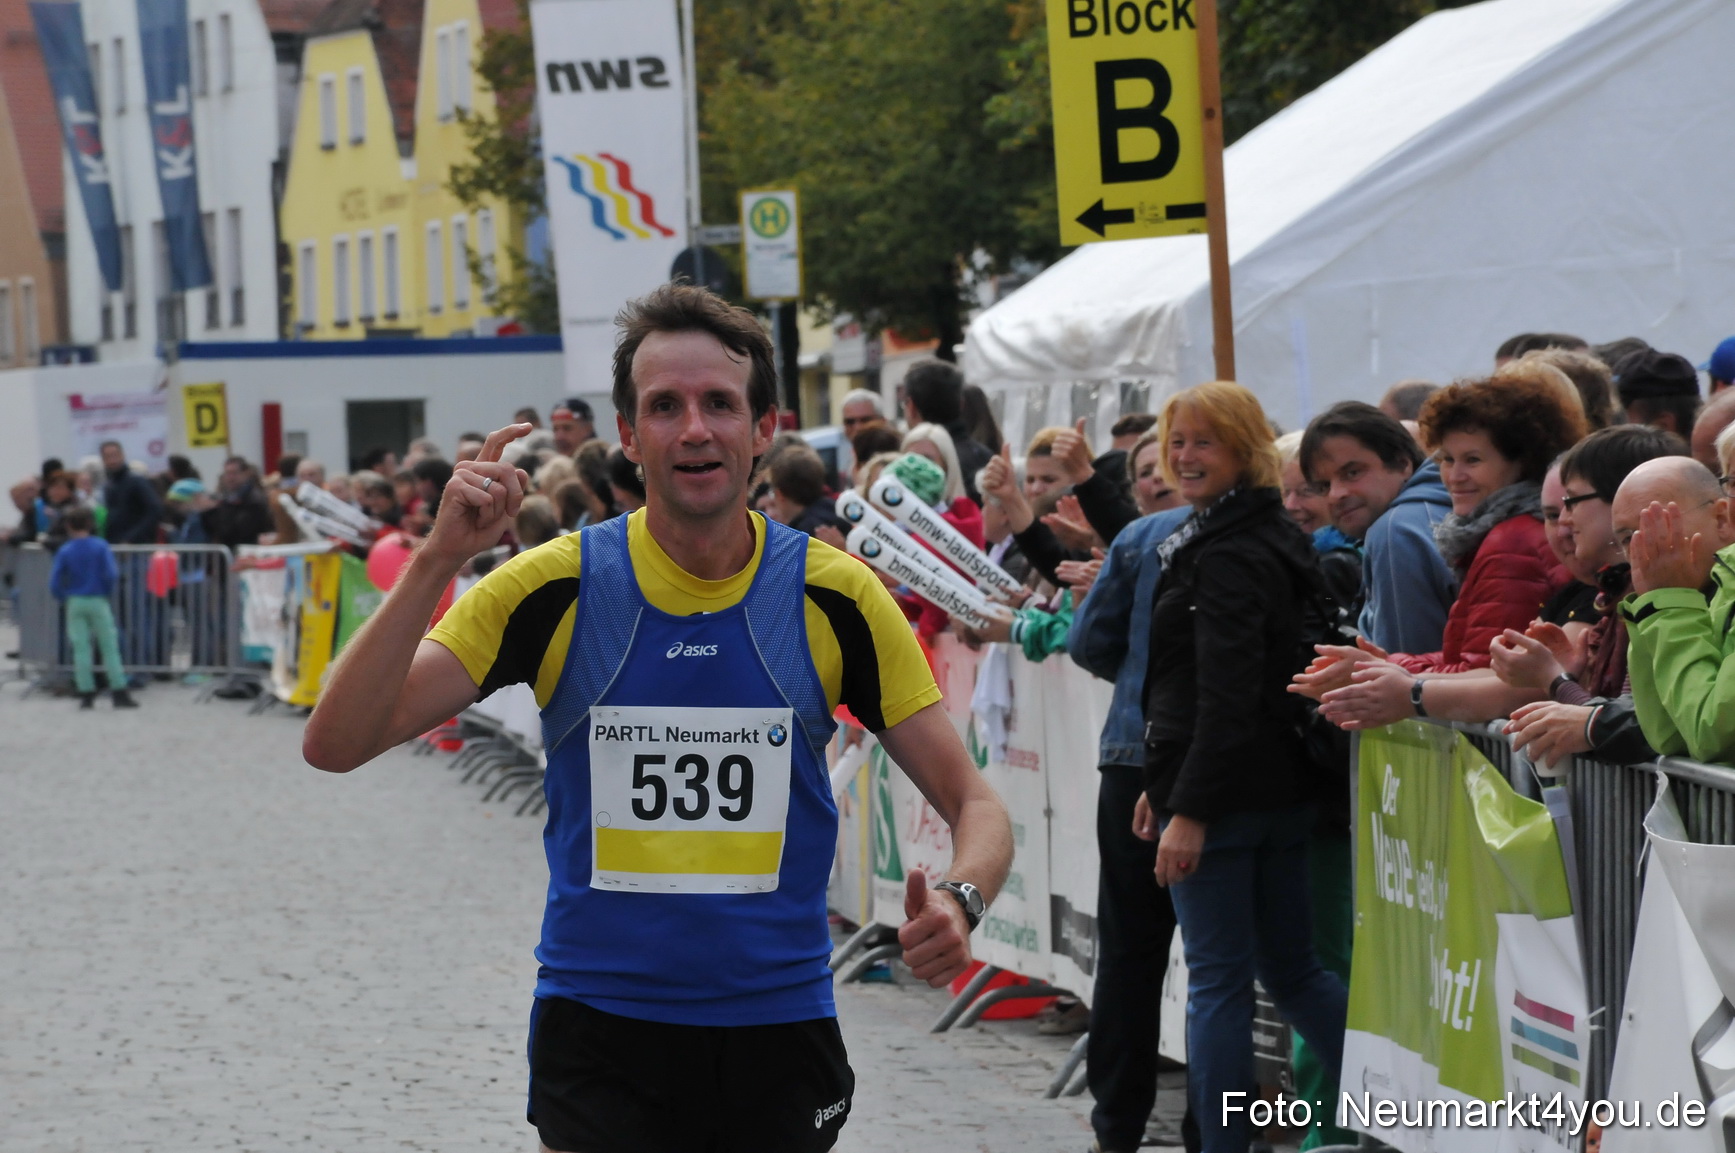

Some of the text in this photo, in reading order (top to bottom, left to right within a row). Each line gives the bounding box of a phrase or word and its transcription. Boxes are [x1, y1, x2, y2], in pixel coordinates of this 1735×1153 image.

[1067, 0, 1197, 38] Block
[1094, 58, 1180, 184] B
[195, 402, 219, 434] D
[683, 644, 718, 657] asics
[594, 724, 660, 743] PARTL
[665, 726, 760, 744] Neumarkt
[631, 753, 754, 822] 539
[1371, 811, 1413, 909] Neue
